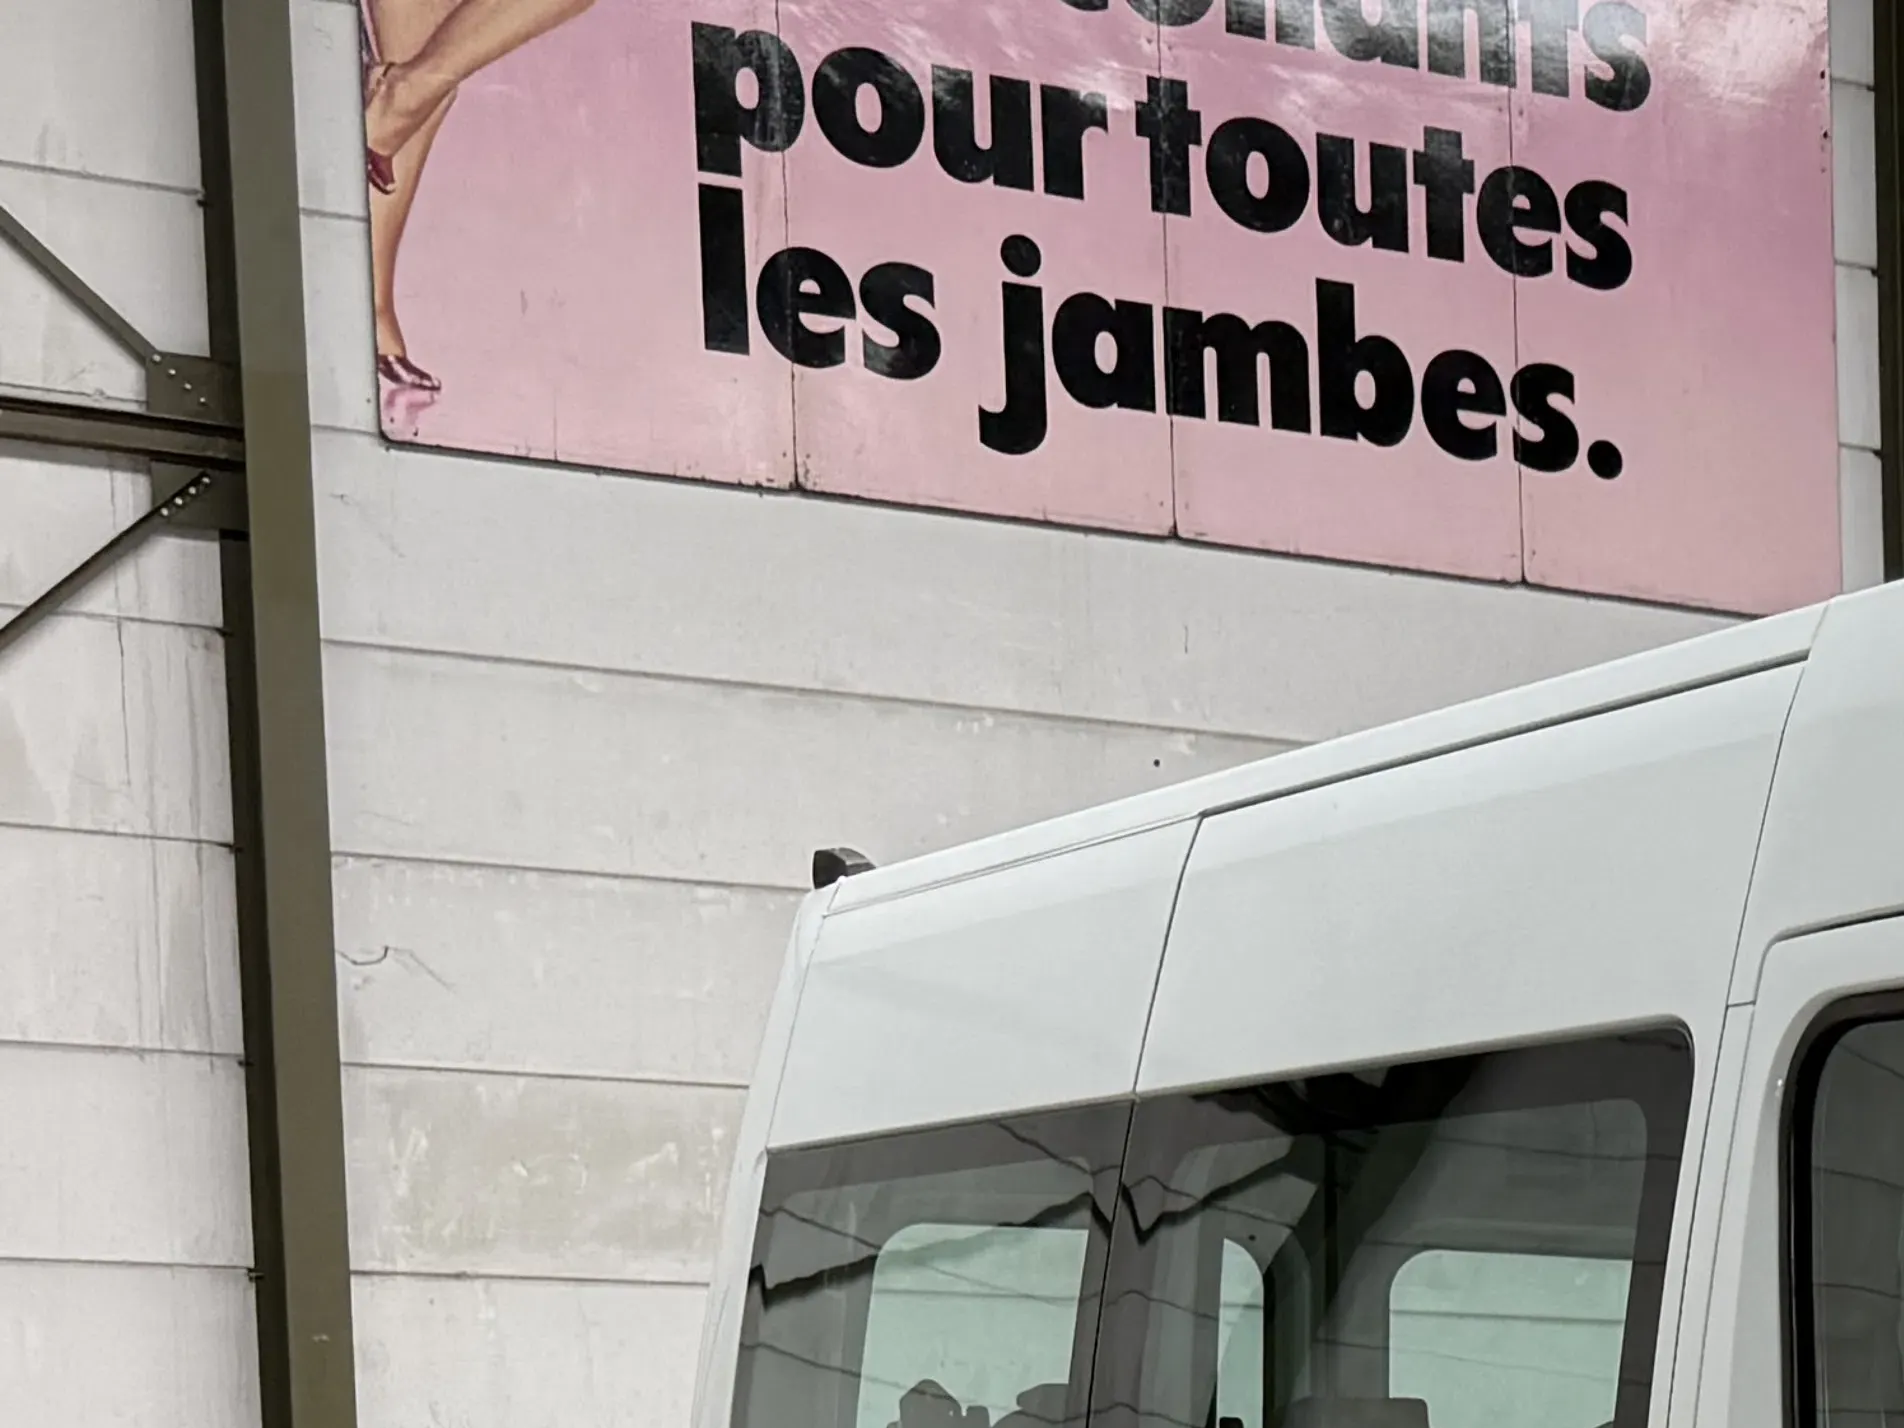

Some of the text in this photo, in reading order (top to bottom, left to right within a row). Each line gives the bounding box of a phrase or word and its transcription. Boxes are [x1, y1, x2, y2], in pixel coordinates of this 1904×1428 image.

[691, 20, 1634, 292] pour toutes
[1060, 0, 1652, 112] ants
[697, 181, 1625, 481] les jambes.
